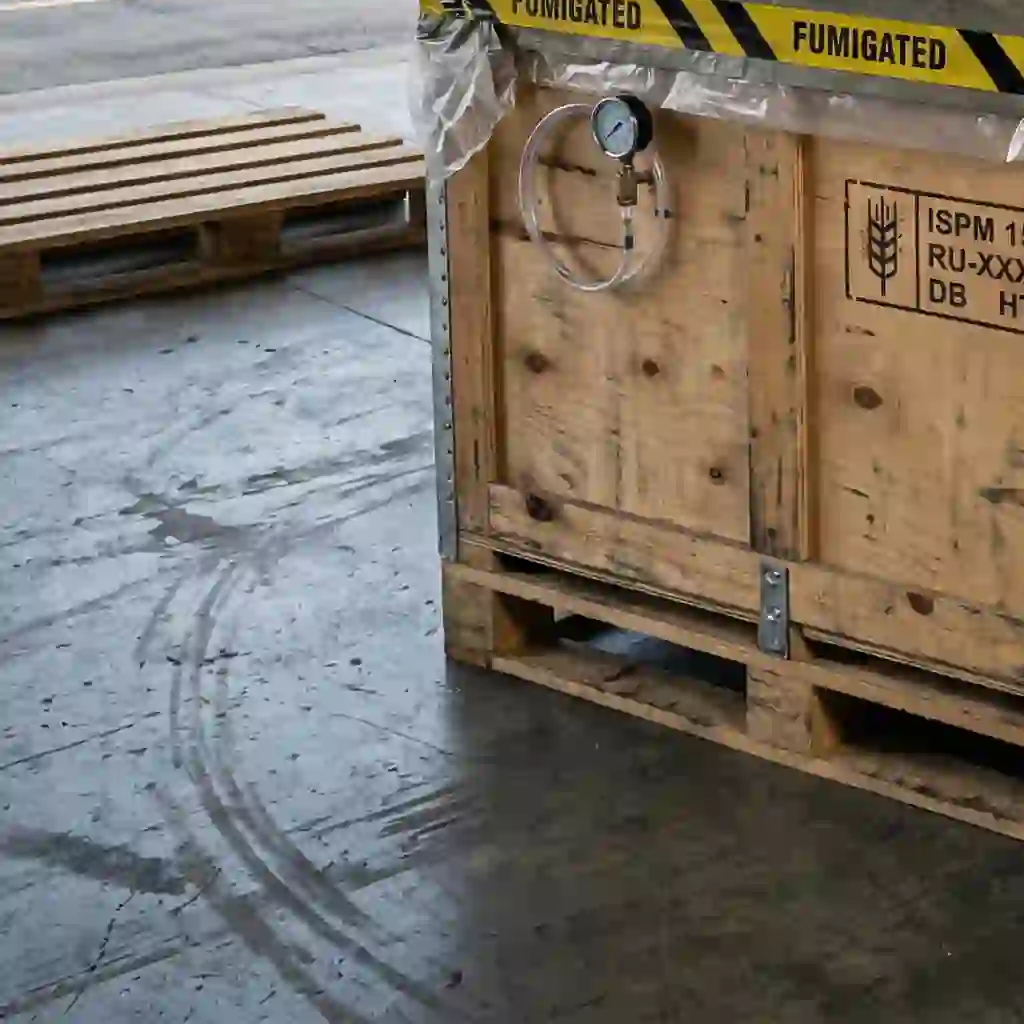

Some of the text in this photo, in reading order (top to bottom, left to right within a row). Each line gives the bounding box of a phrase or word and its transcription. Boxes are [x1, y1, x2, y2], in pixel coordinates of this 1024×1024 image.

[792, 20, 947, 71] FUMIGATED
[928, 207, 995, 243] ISPM
[929, 278, 967, 308] DB
